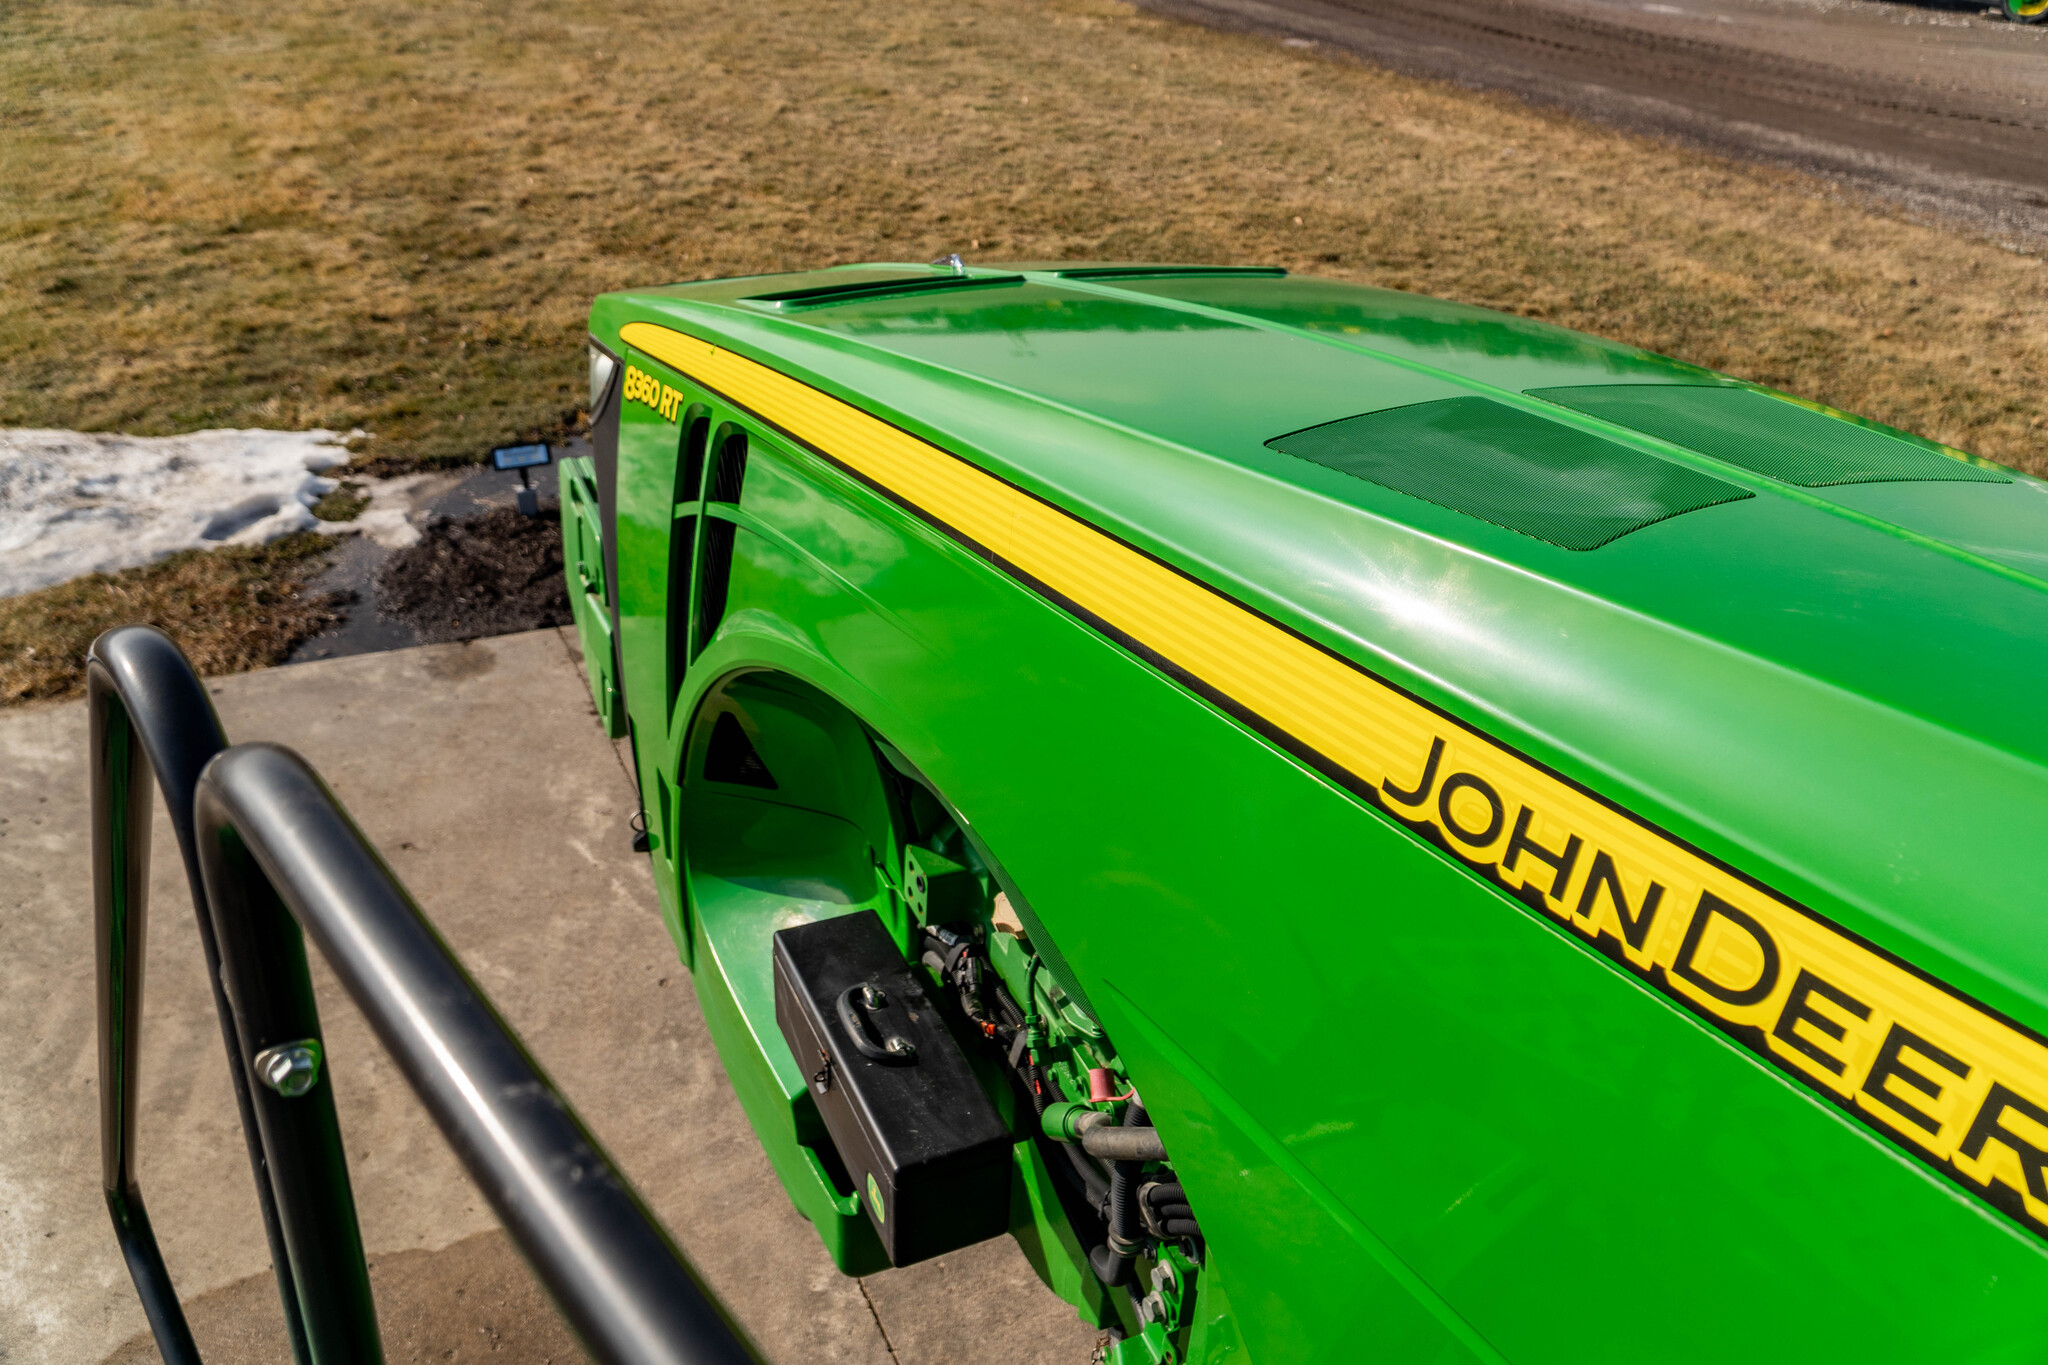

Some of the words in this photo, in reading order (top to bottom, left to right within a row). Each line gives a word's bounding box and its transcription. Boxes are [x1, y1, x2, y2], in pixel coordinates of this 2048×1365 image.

[623, 364, 660, 409] 8360
[659, 384, 684, 423] RT
[1381, 734, 1668, 954] JOHN
